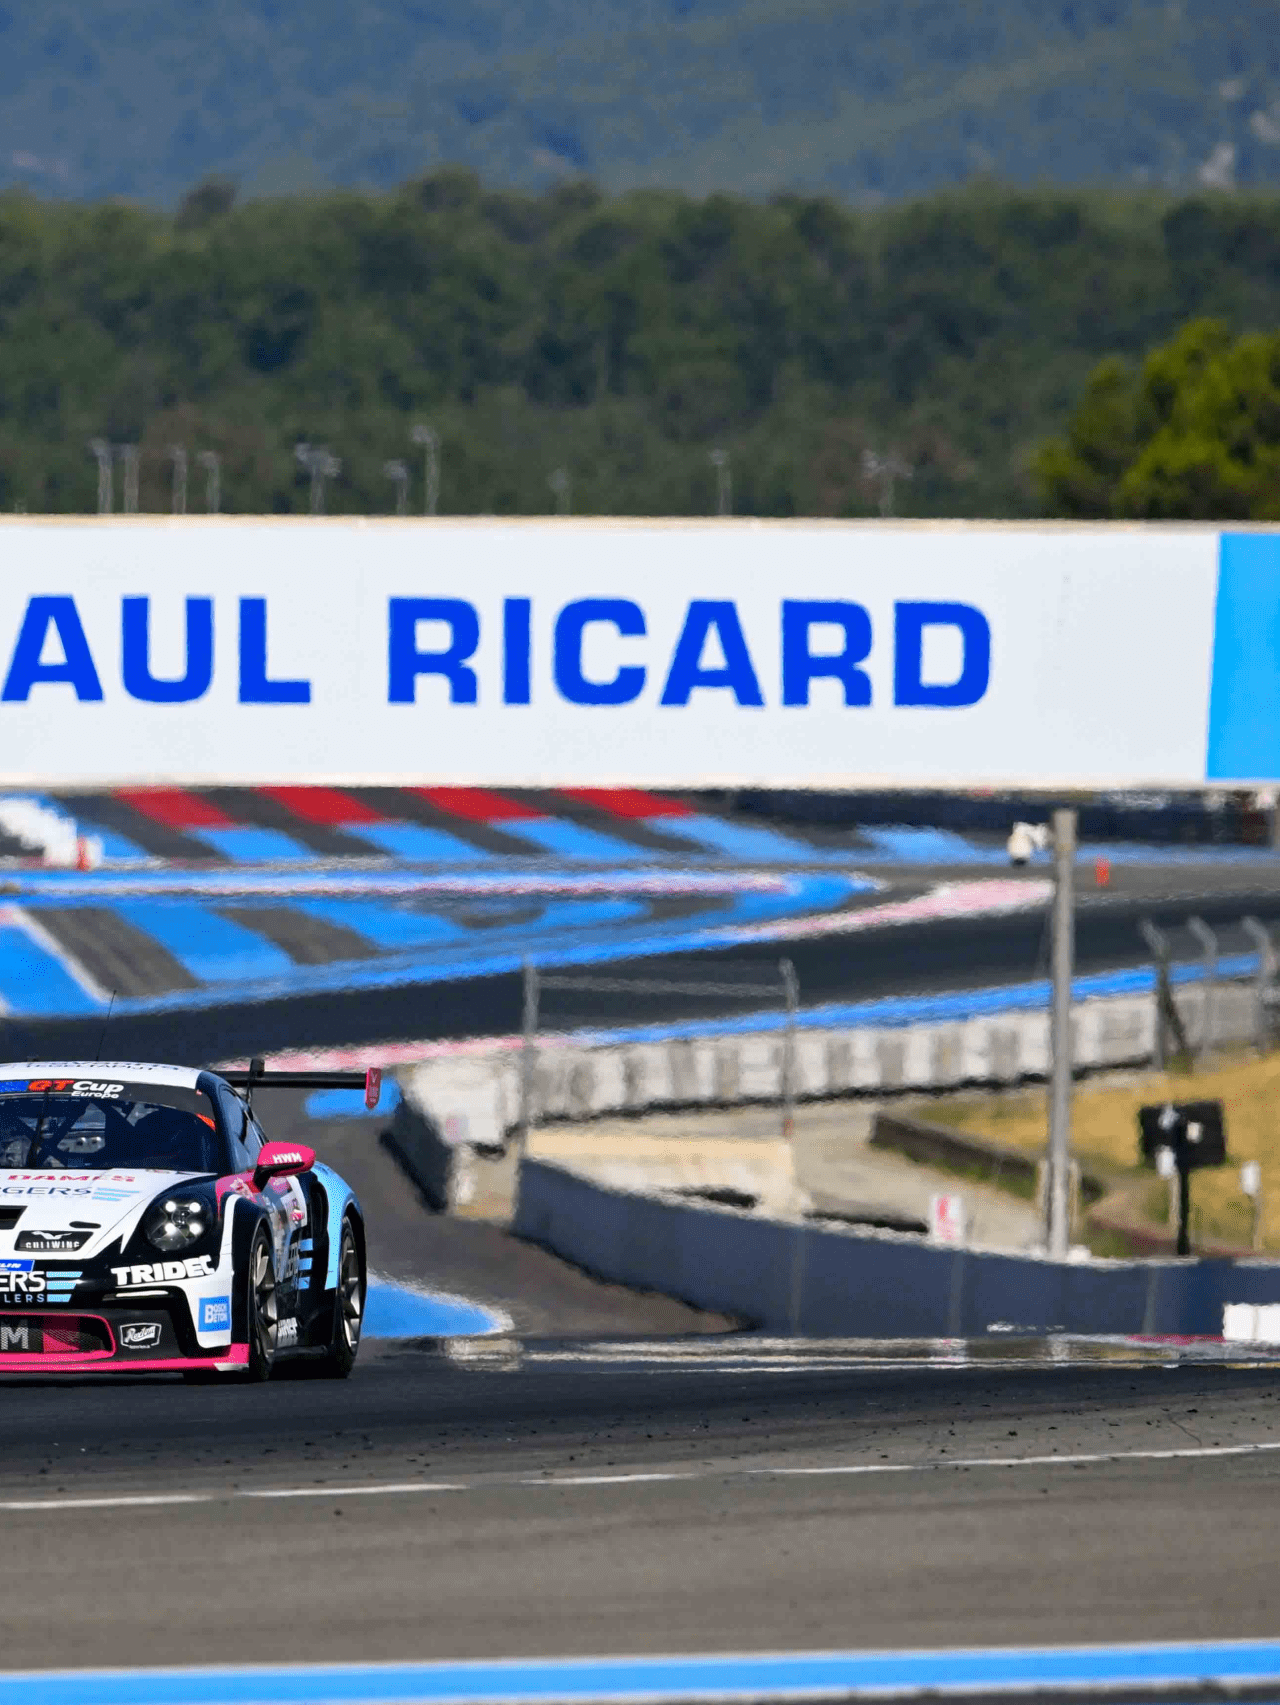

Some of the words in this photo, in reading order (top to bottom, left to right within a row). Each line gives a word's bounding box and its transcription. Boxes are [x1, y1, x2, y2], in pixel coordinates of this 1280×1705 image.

[386, 595, 992, 708] RICARD
[28, 1079, 75, 1092] GT
[72, 1080, 125, 1093] Cup
[70, 1090, 120, 1099] Europe
[272, 1151, 303, 1164] HWM
[110, 1254, 217, 1287] TRIDEC
